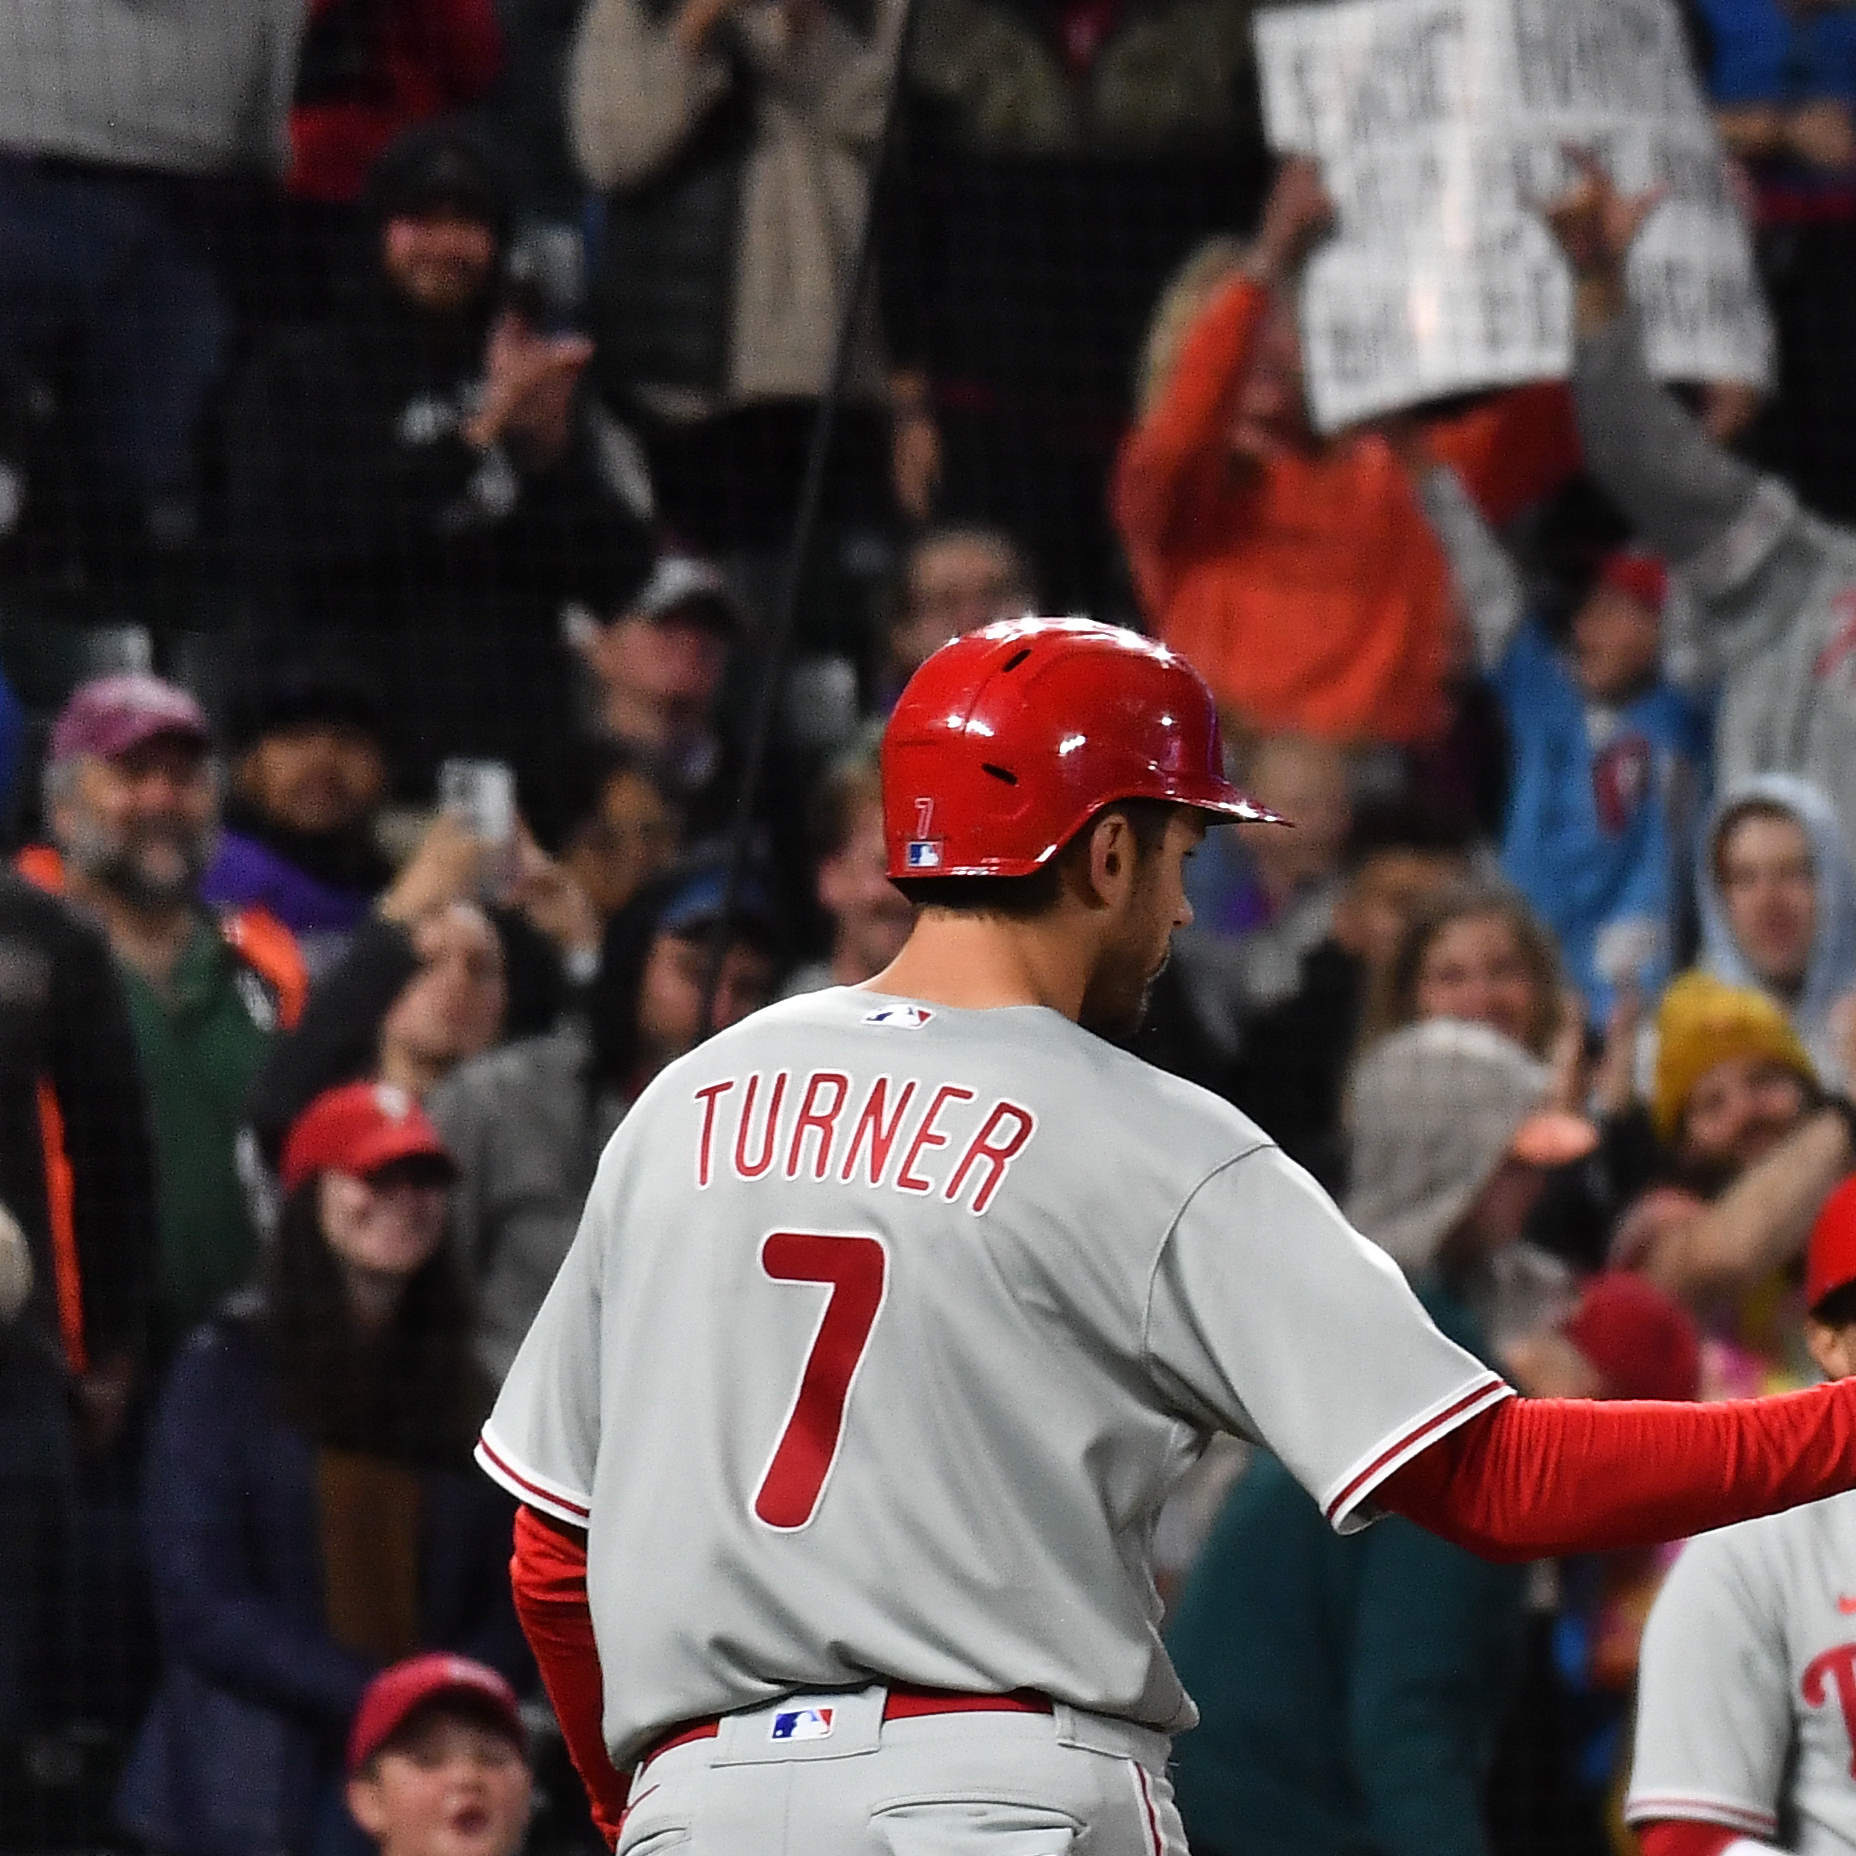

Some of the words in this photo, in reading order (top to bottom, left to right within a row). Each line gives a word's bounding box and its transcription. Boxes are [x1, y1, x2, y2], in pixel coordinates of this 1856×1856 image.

[914, 796, 935, 840] 7
[693, 1067, 1038, 1219] TURNER
[754, 1226, 890, 1534] 7
